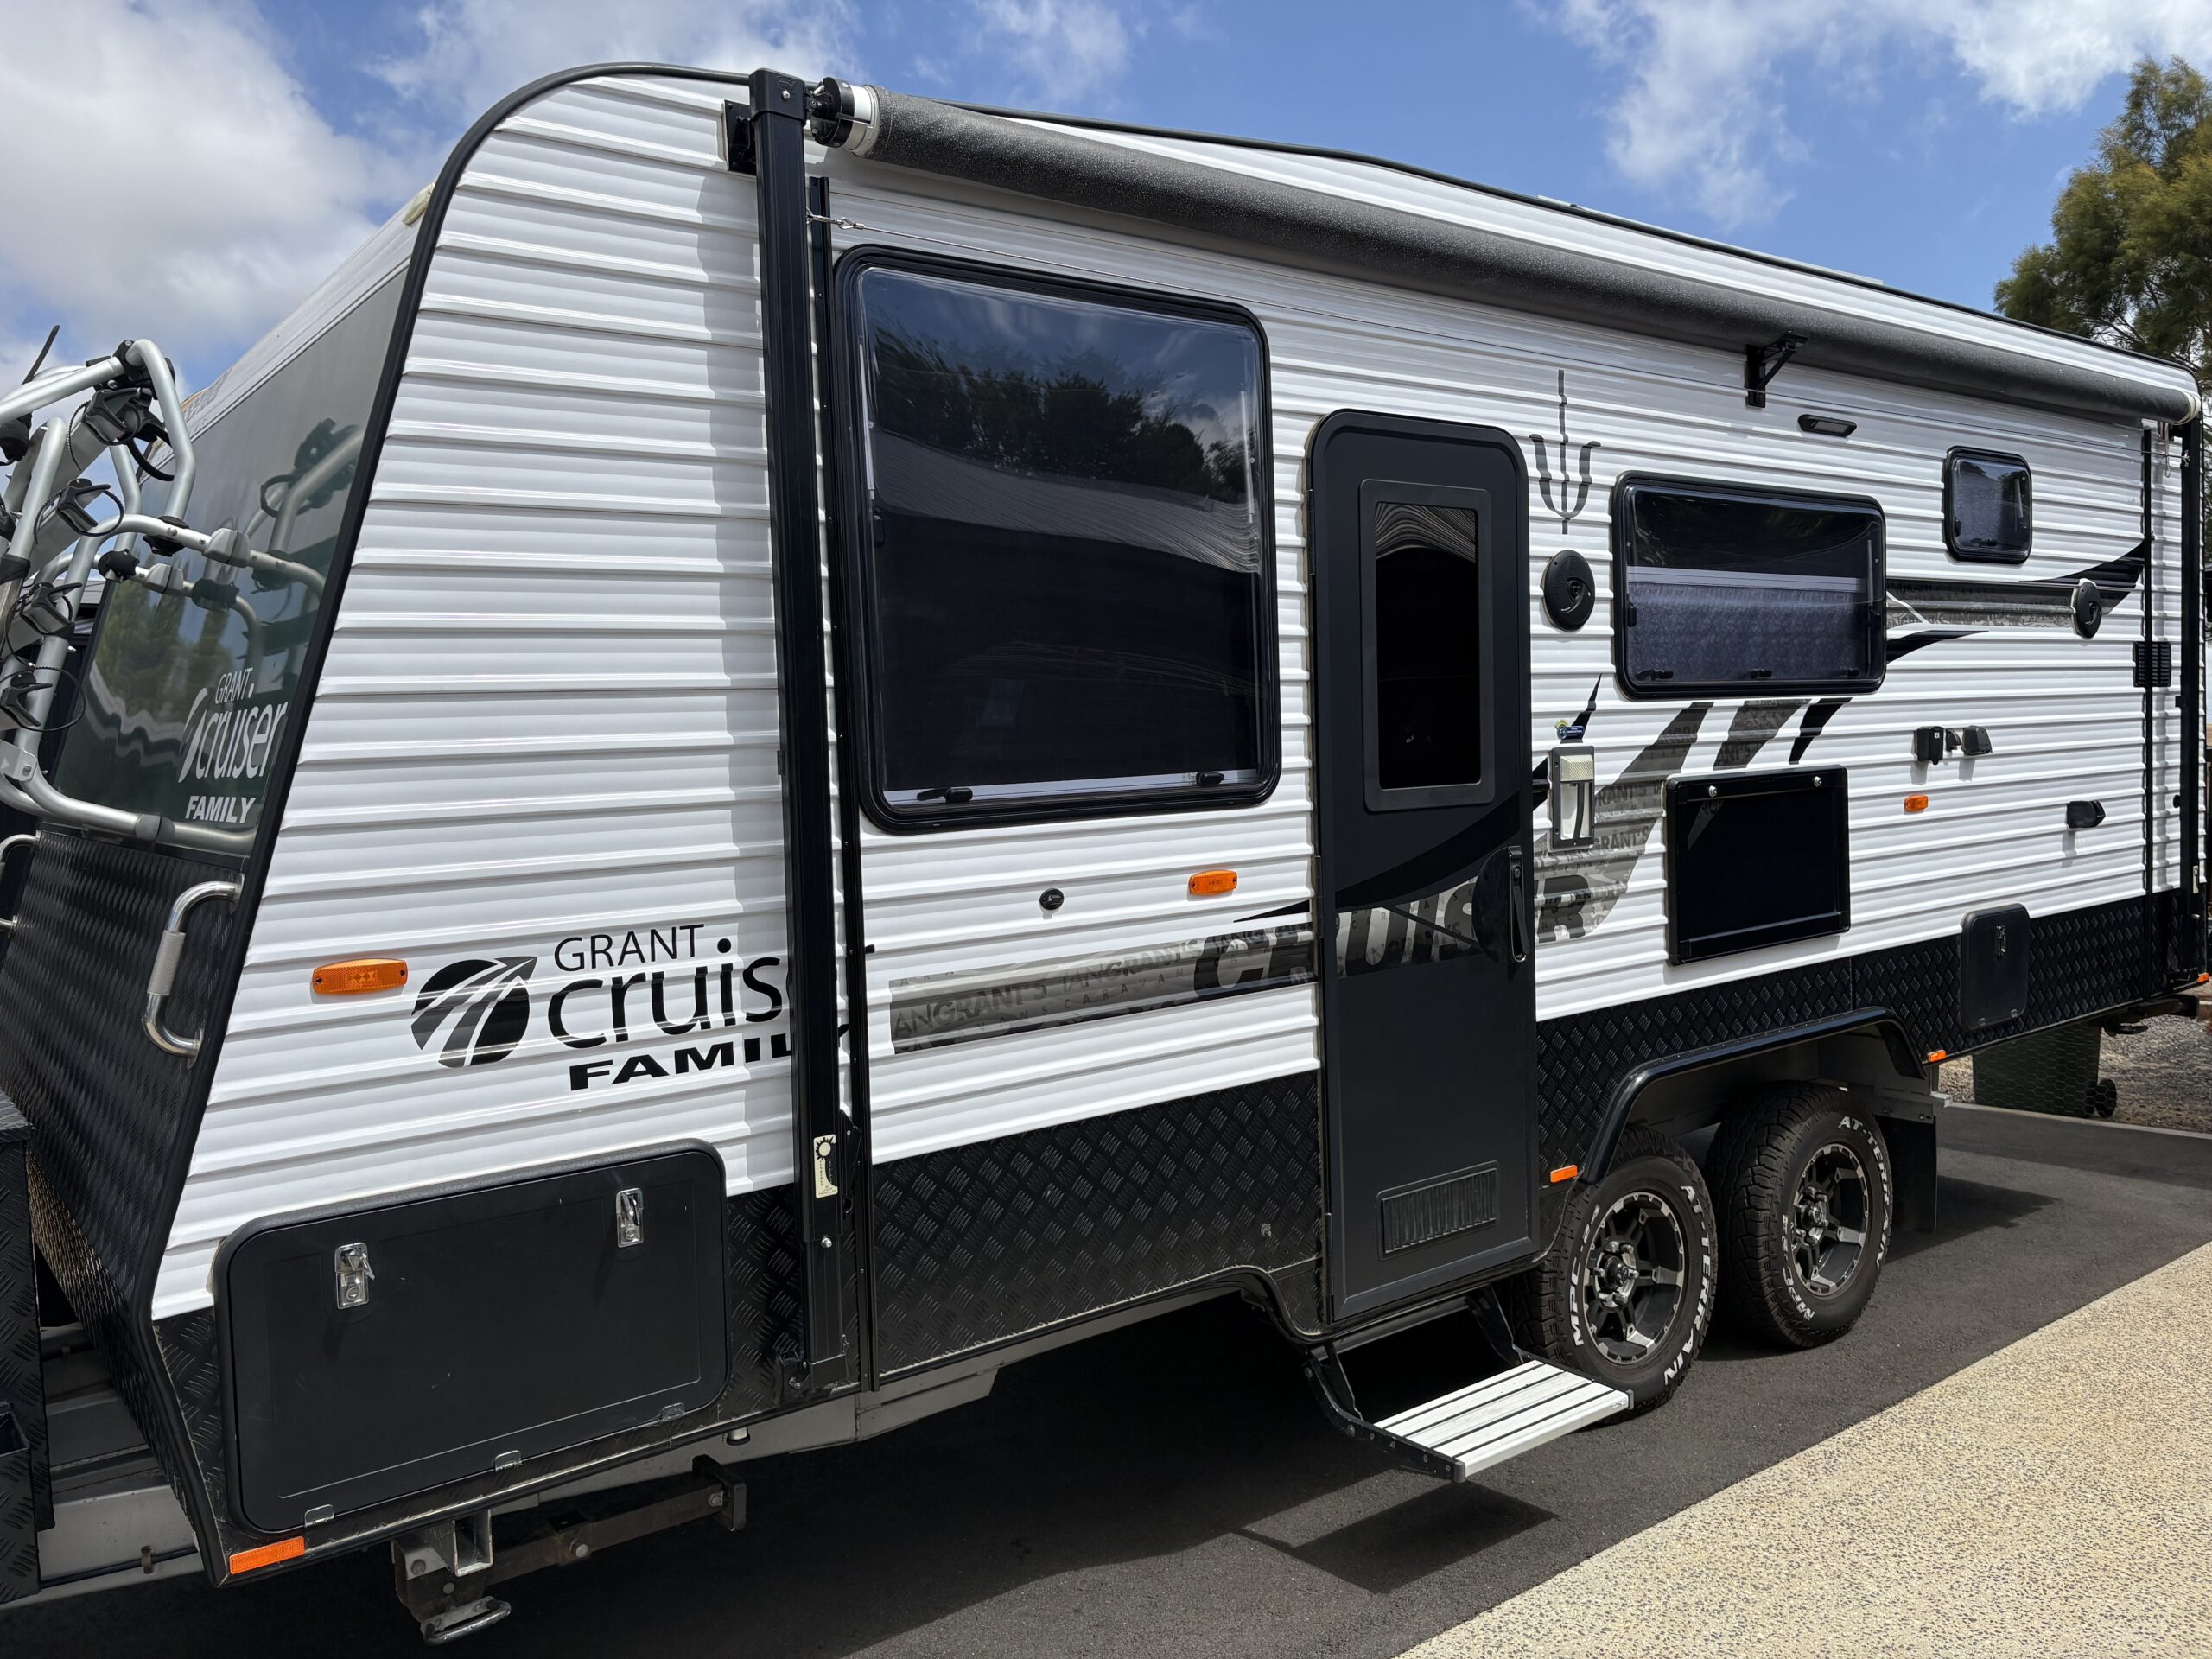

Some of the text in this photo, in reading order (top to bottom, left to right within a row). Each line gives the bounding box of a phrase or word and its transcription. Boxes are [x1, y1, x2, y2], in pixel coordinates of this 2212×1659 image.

[215, 667, 253, 704] GRANT
[195, 683, 289, 779] cruiser
[185, 795, 257, 823] FAMILY
[554, 924, 704, 971] GRANT
[548, 938, 874, 1048] cruis
[569, 1023, 850, 1090] FAMIL
[1838, 1116, 1890, 1271] AT-TERRAIN
[1663, 1185, 1710, 1386] AT-TERRAIN
